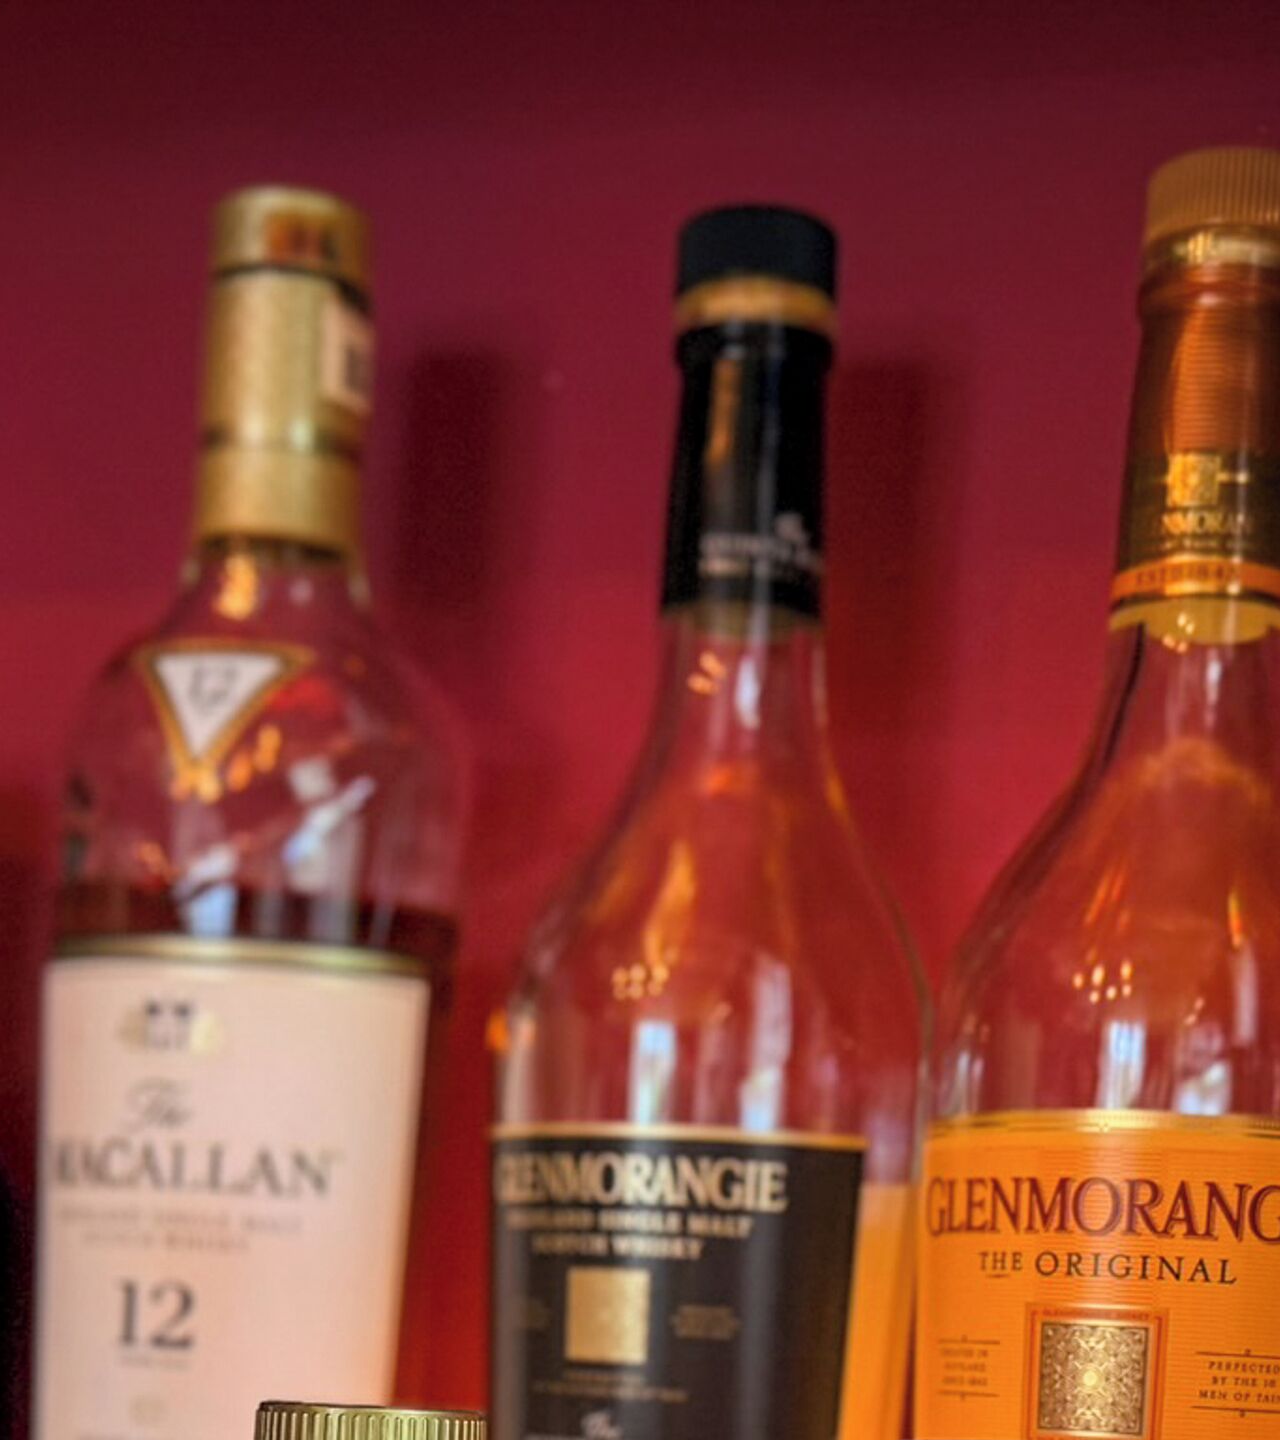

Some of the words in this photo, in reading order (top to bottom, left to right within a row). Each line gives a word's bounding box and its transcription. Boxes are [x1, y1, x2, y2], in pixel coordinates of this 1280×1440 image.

[979, 1251, 1024, 1273] THE
[1034, 1251, 1238, 1286] ORIGINAL
[115, 1277, 196, 1353] 12
